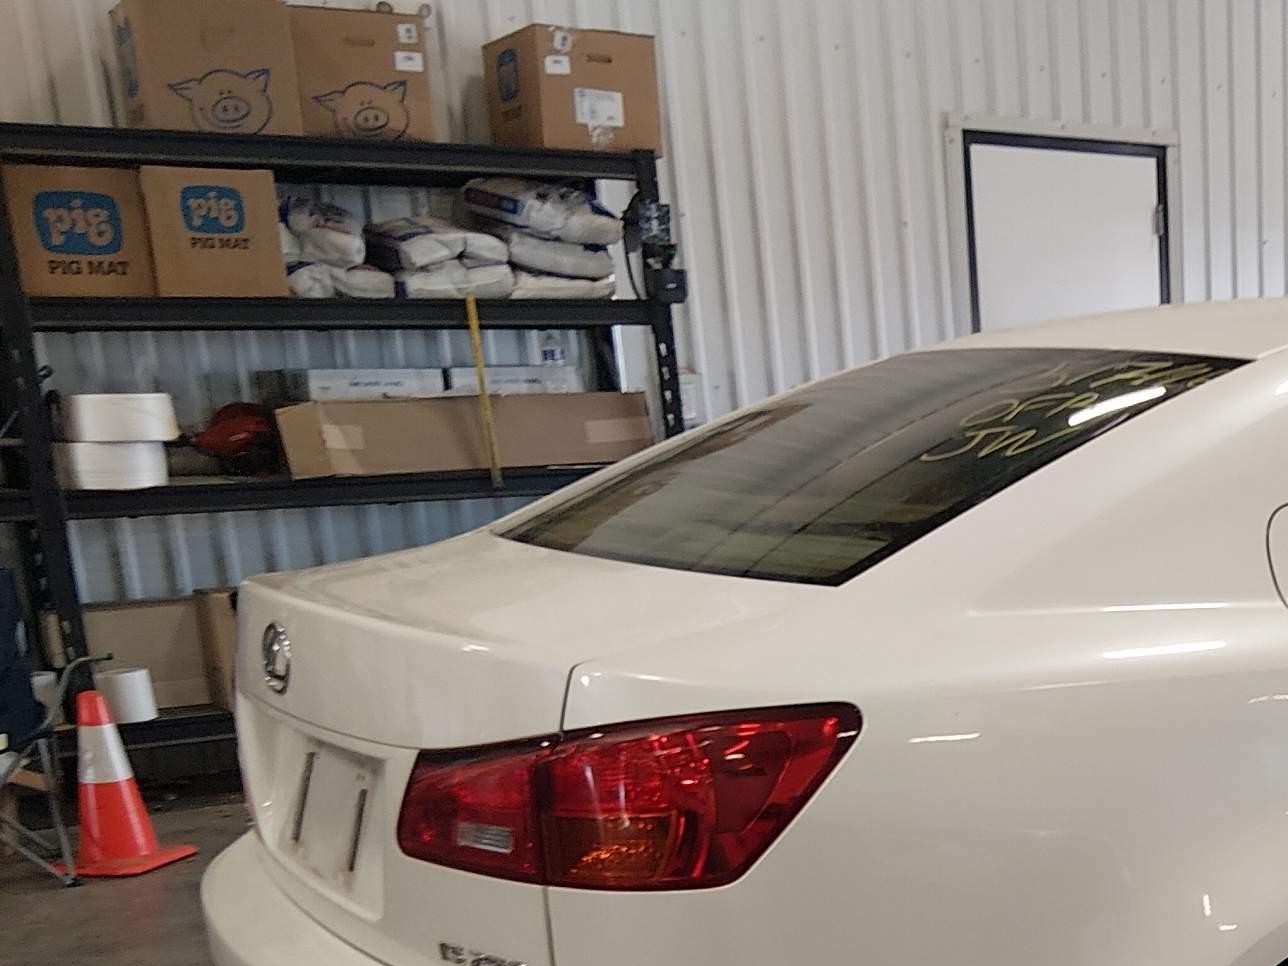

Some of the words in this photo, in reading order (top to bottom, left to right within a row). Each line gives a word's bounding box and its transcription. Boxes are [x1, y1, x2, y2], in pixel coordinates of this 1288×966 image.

[42, 198, 115, 247] pig
[188, 191, 239, 228] pig
[191, 236, 216, 250] PIG
[218, 237, 250, 250] MAT
[48, 258, 82, 276] PIG
[88, 260, 129, 276] MAT
